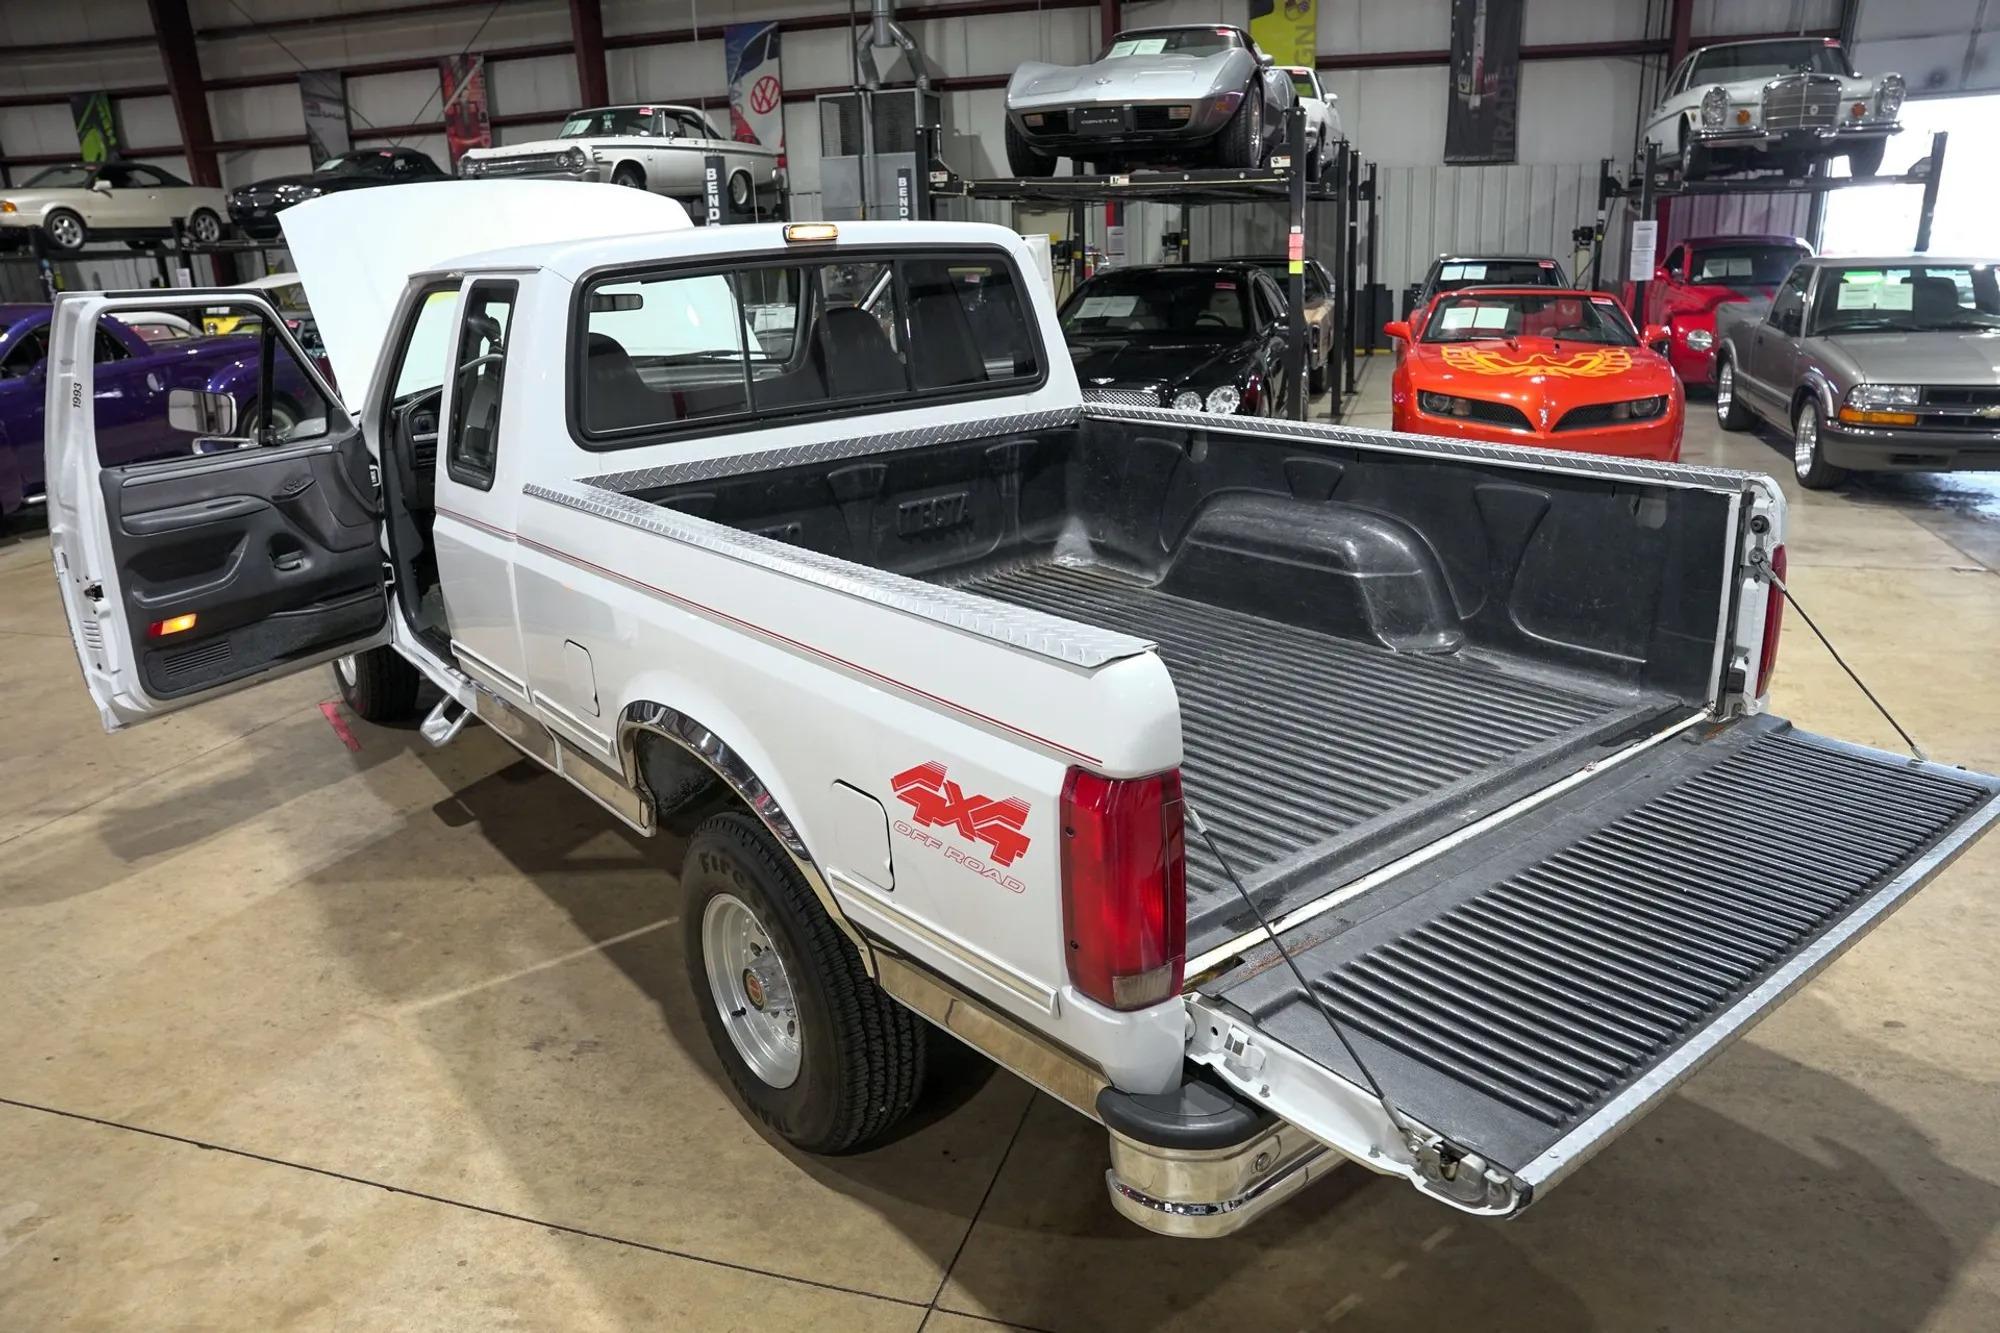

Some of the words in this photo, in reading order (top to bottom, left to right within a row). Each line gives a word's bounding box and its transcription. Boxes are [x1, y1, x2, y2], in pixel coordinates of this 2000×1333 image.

[706, 168, 720, 226] BEND
[898, 177, 909, 221] BEND
[72, 382, 83, 408] 1993
[893, 820, 943, 850] OFF
[944, 846, 1026, 894] ROAD
